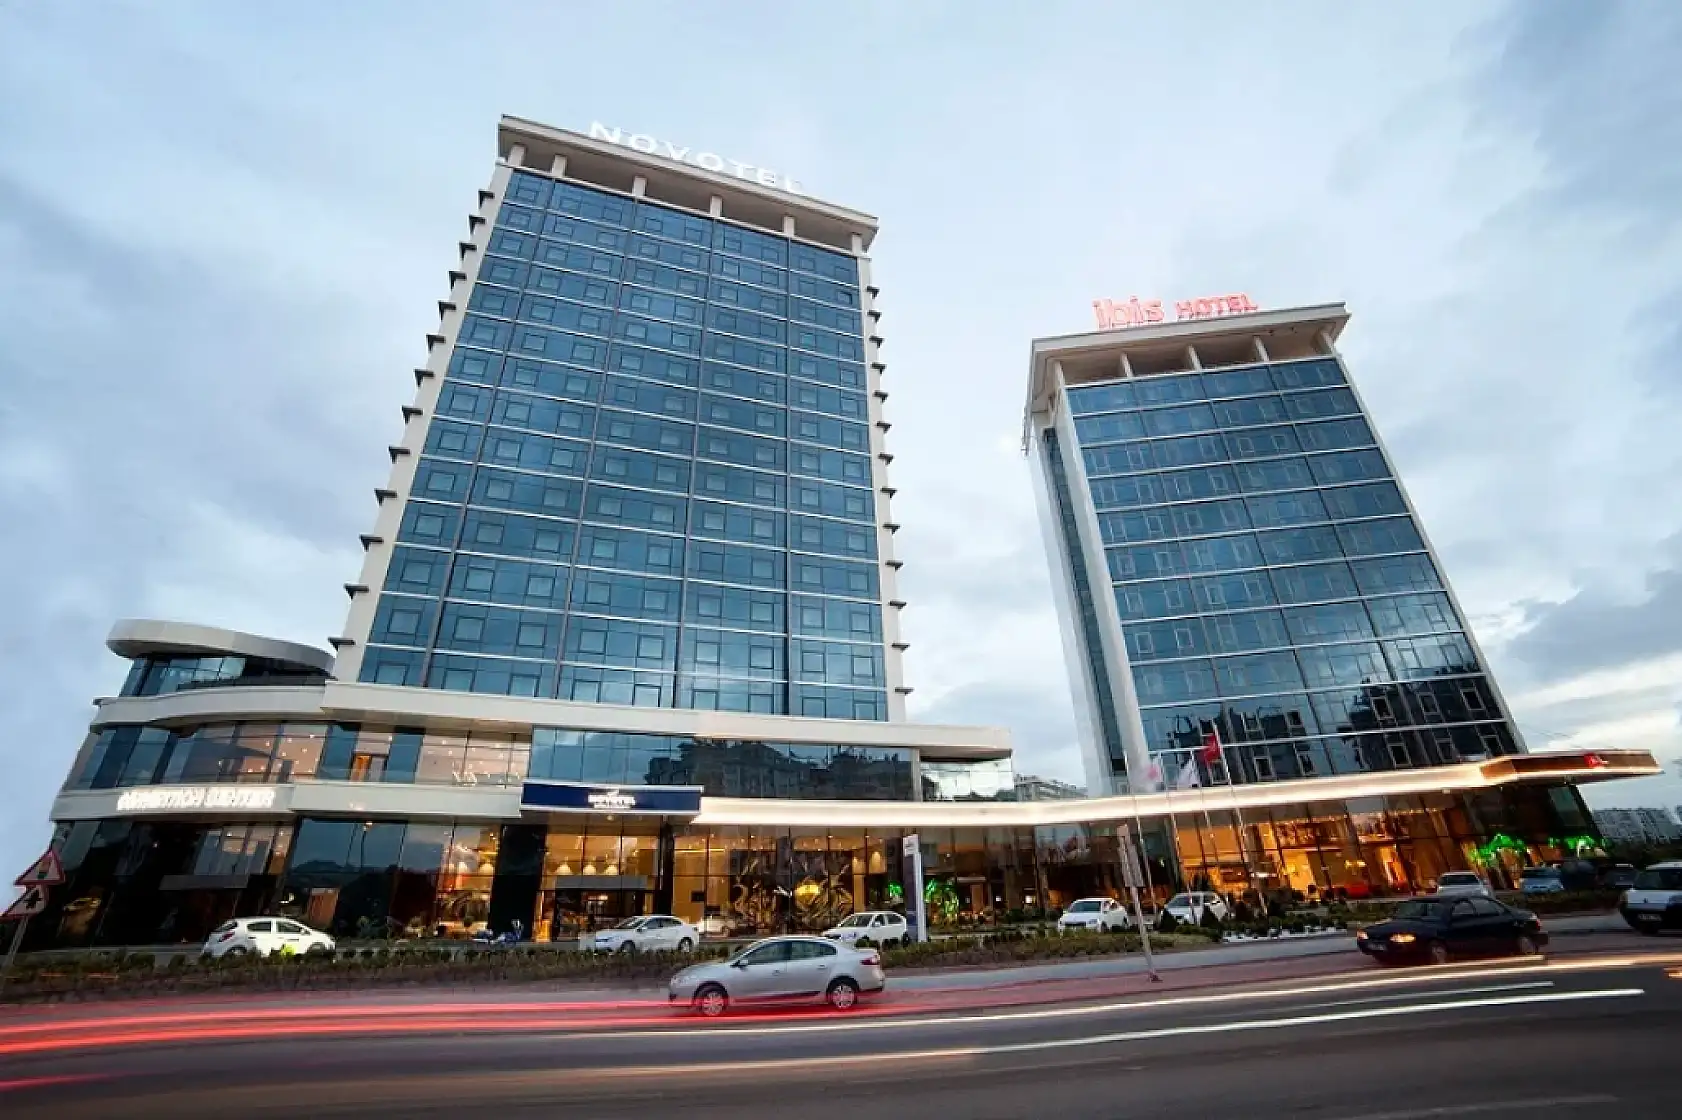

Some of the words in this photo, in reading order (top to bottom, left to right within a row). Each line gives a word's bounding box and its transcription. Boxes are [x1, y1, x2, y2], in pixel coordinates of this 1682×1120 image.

[589, 120, 804, 195] NOVOTEL
[1092, 295, 1165, 331] ibis
[1175, 292, 1258, 321] HOTEL
